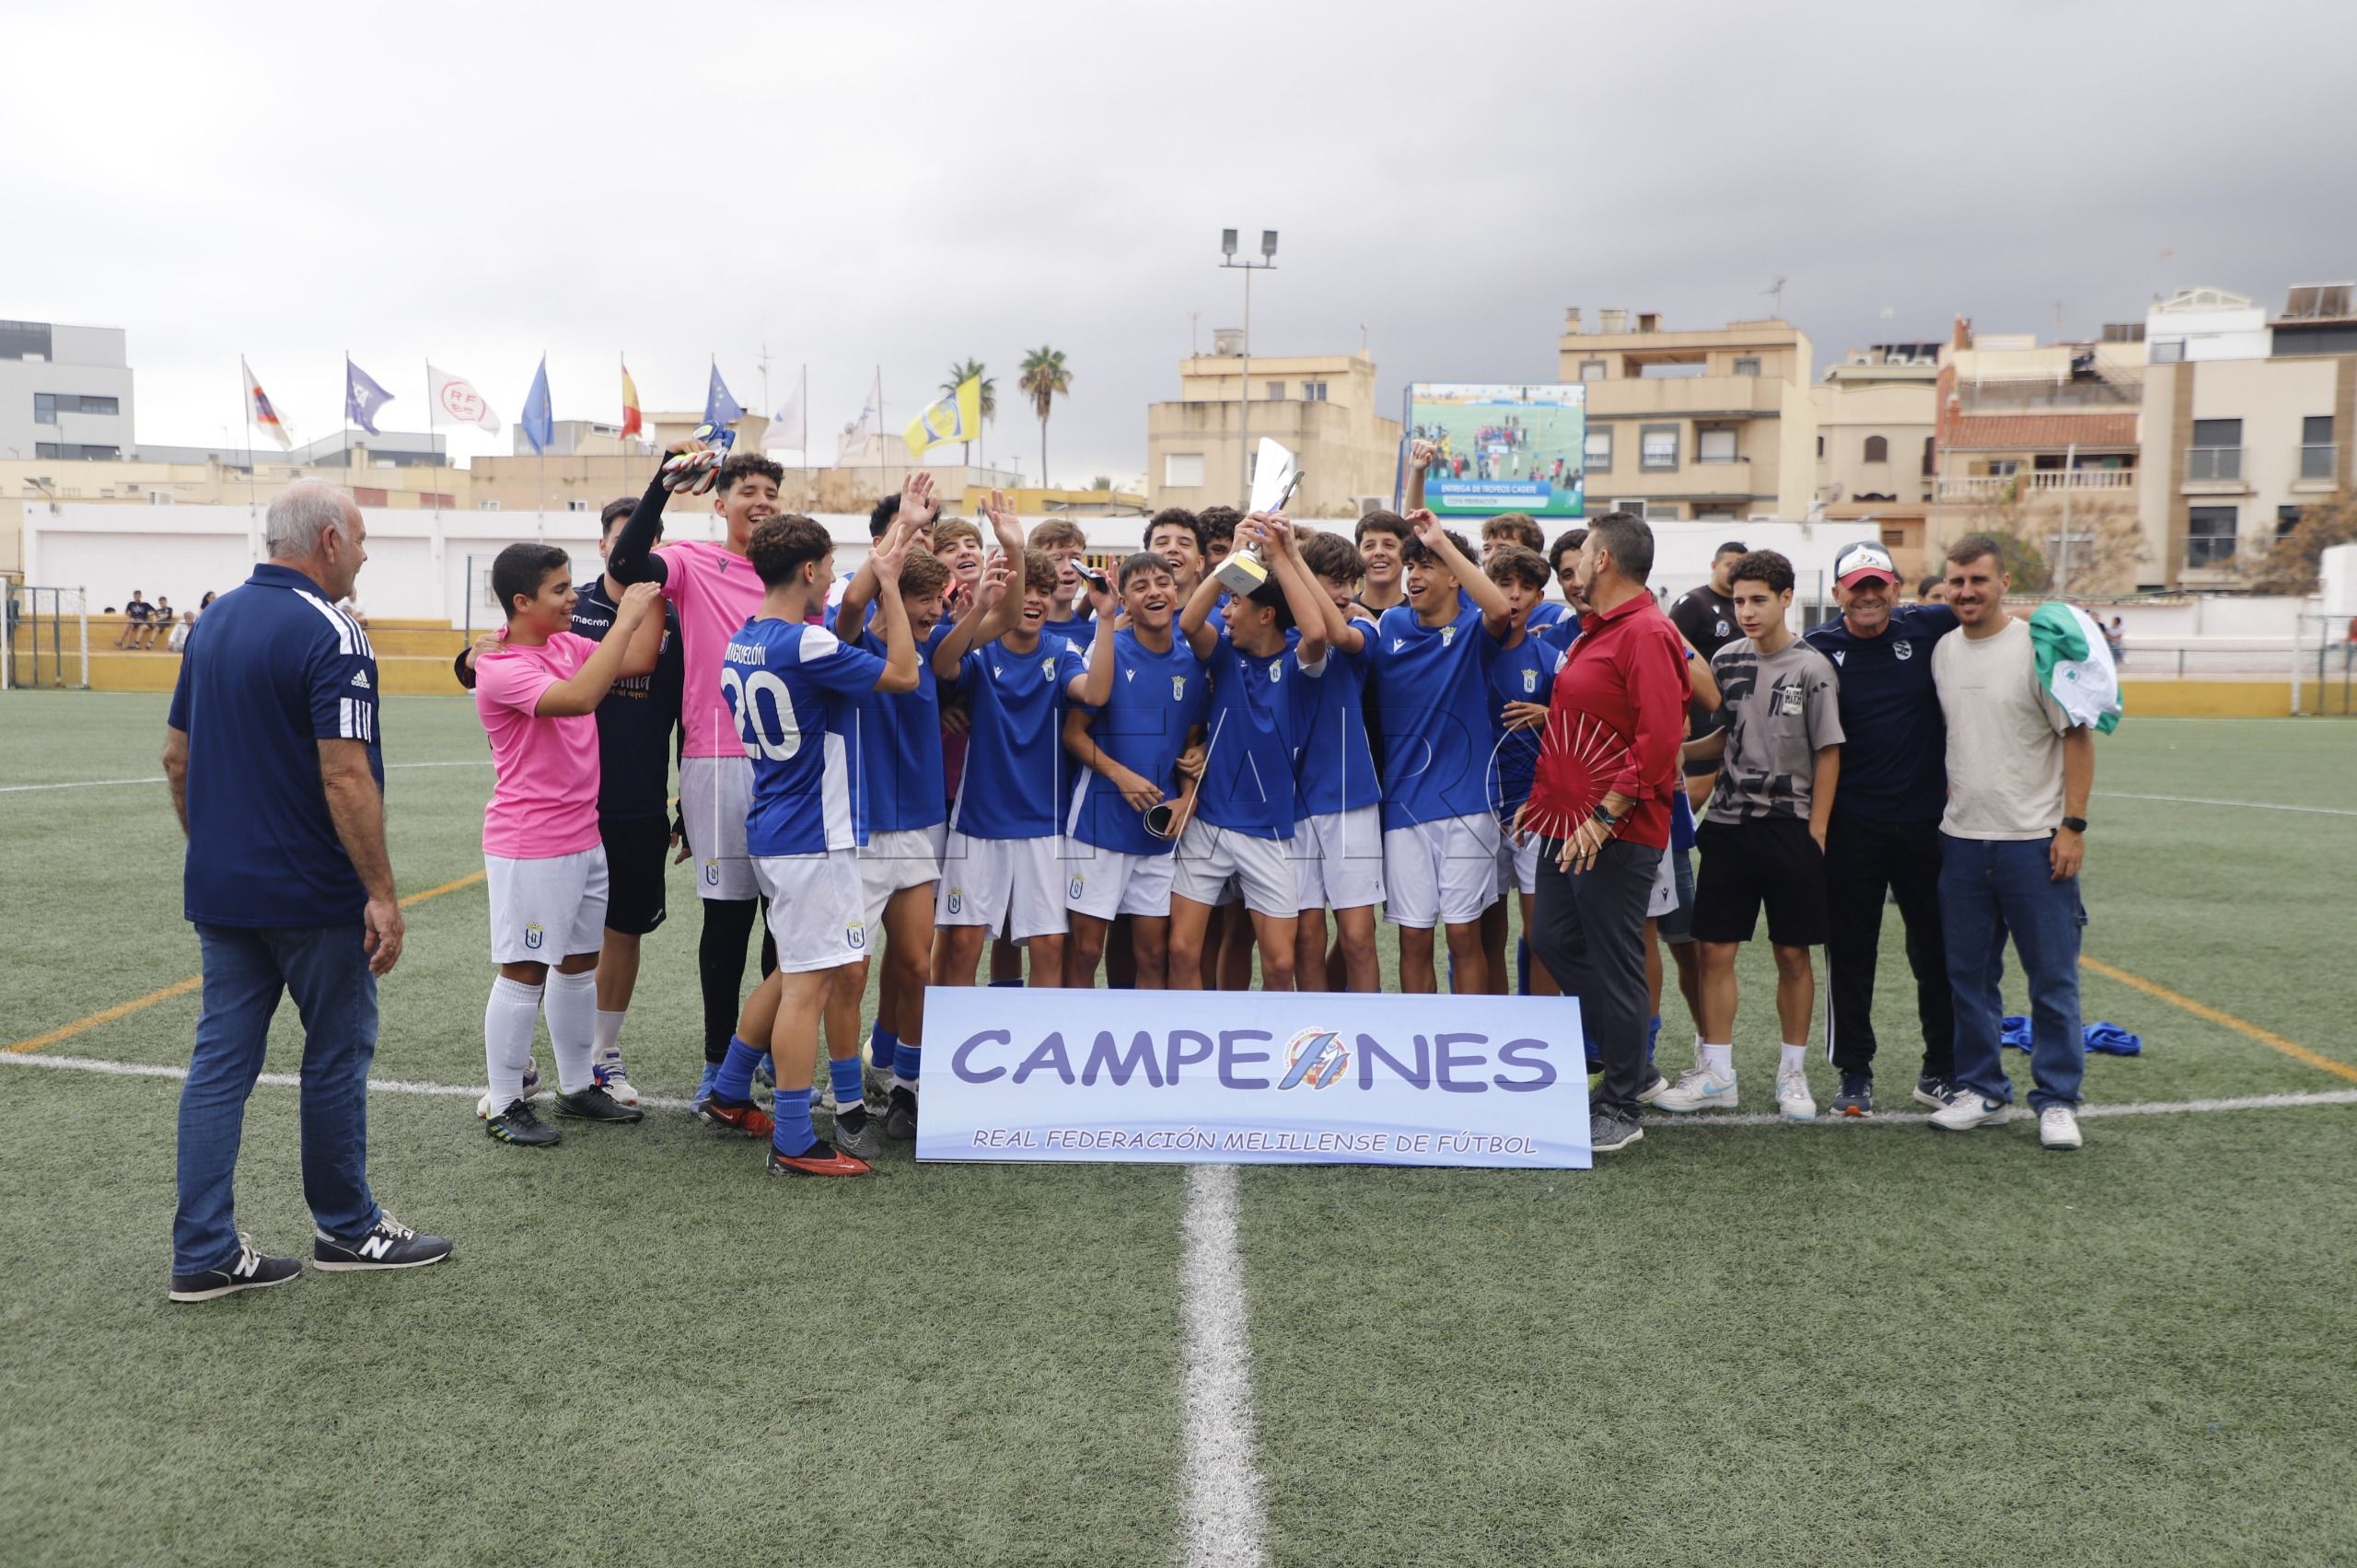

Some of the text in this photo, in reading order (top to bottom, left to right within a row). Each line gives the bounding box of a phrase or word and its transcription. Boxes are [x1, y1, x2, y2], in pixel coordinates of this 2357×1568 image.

[1471, 484, 1481, 494] DE
[572, 614, 610, 627] macron
[351, 679, 370, 690] adidas
[721, 668, 801, 761] 20
[972, 1126, 1538, 1155] REAL FEDERACIÓN MELILLENSE DE FÚTBOL
[358, 1236, 393, 1260] N
